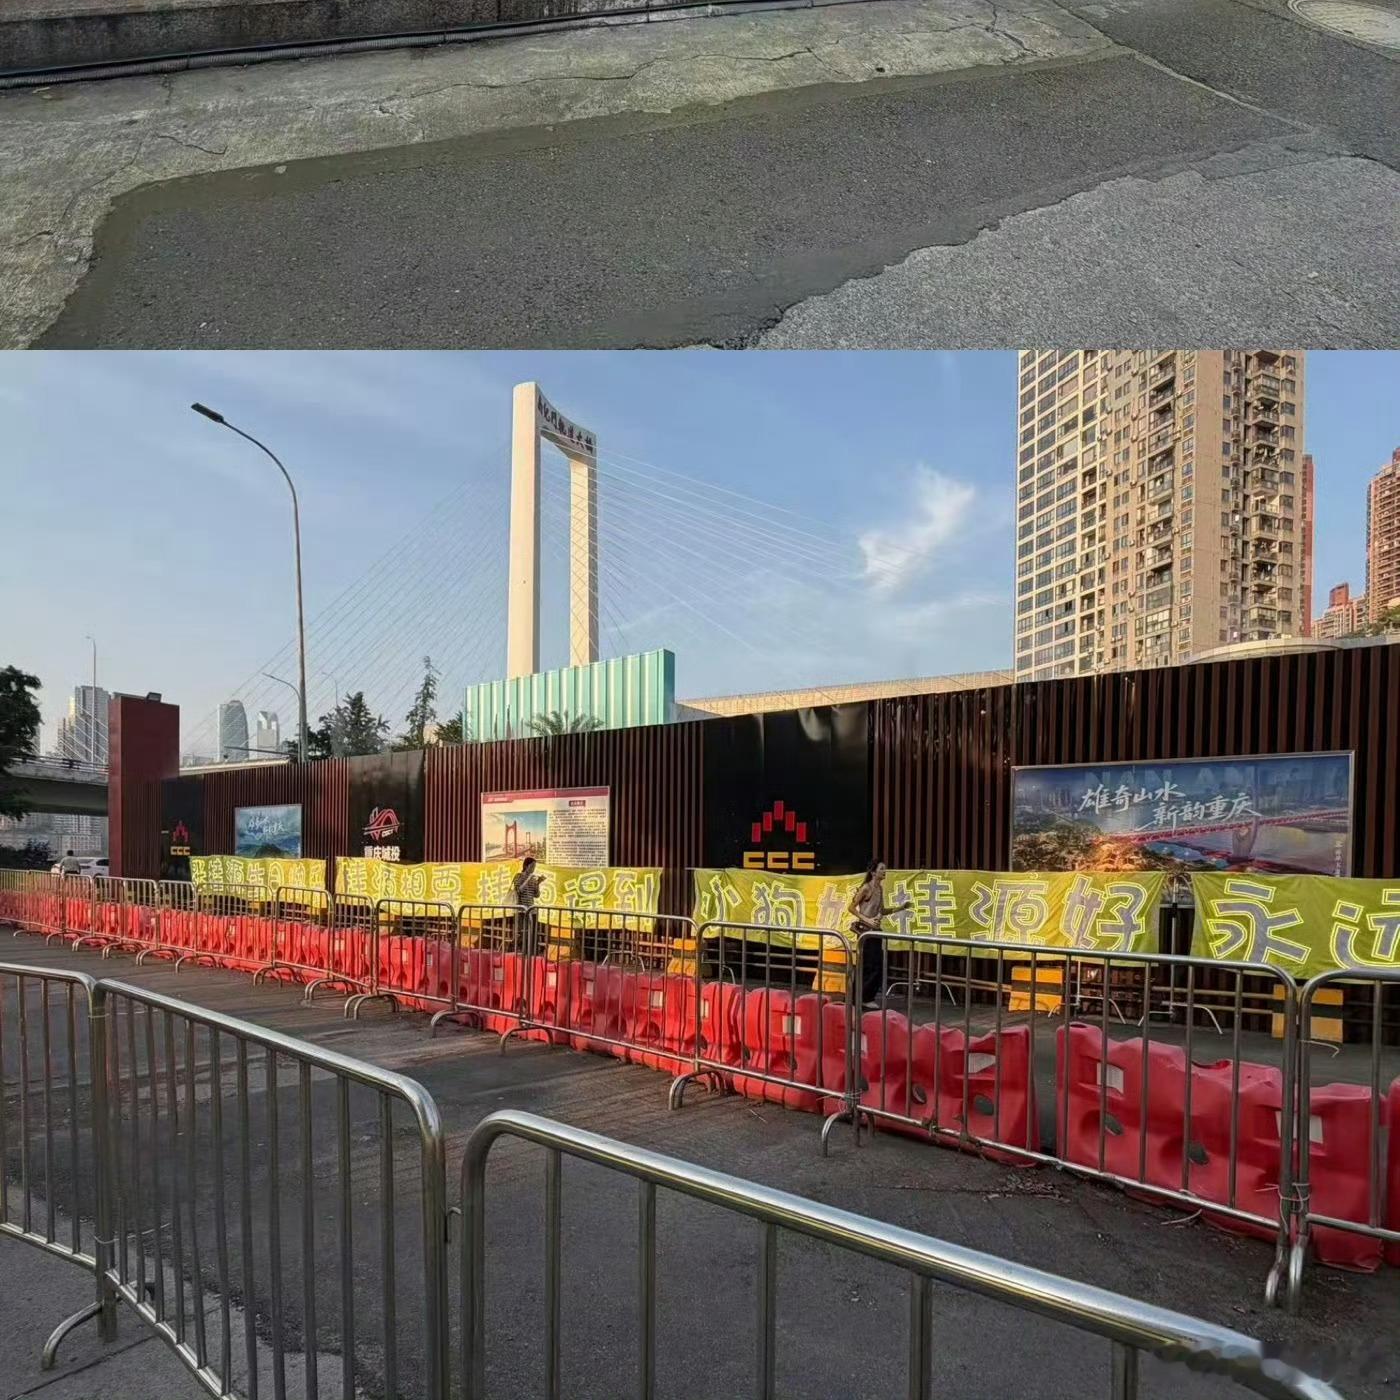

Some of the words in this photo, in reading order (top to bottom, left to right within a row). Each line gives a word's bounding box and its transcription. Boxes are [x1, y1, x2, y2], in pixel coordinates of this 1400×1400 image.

[1078, 781, 1186, 814] 雄奇山水
[1139, 793, 1264, 831] 新韵重庆
[743, 852, 815, 870] CCC
